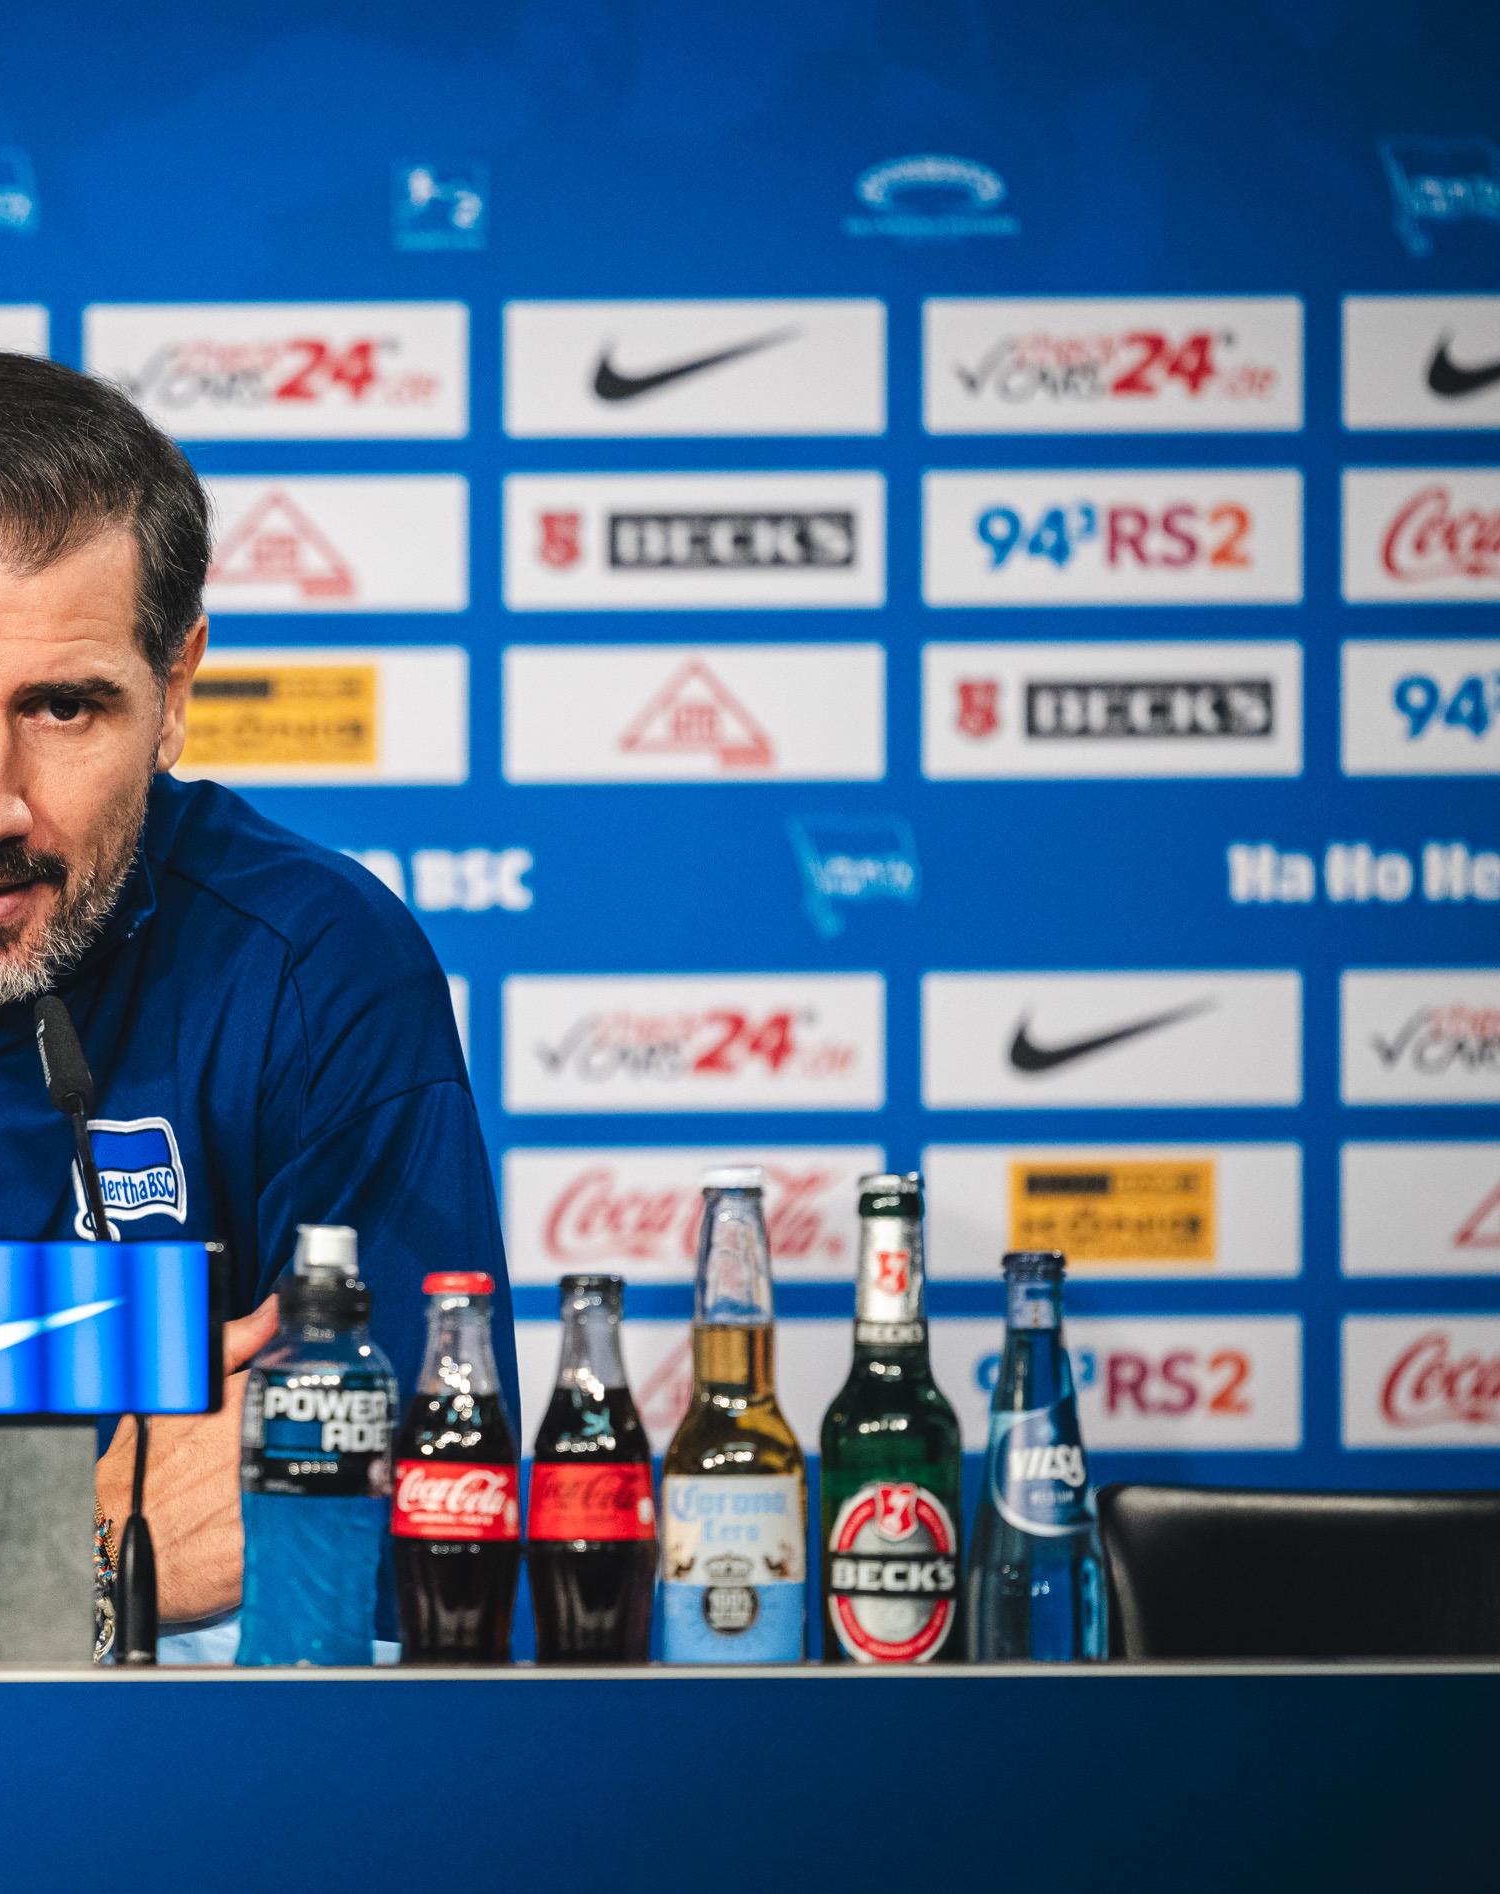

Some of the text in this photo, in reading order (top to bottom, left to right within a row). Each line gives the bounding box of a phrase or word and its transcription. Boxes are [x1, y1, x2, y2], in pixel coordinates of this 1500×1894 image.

[274, 338, 379, 403] 24
[1110, 331, 1215, 396] 24
[412, 848, 534, 912] BSC
[1228, 843, 1315, 903] Ha
[1324, 843, 1413, 902] Ho
[693, 1011, 798, 1076] 24
[264, 1386, 388, 1422] POWER
[398, 1467, 508, 1515] Coca-Cola
